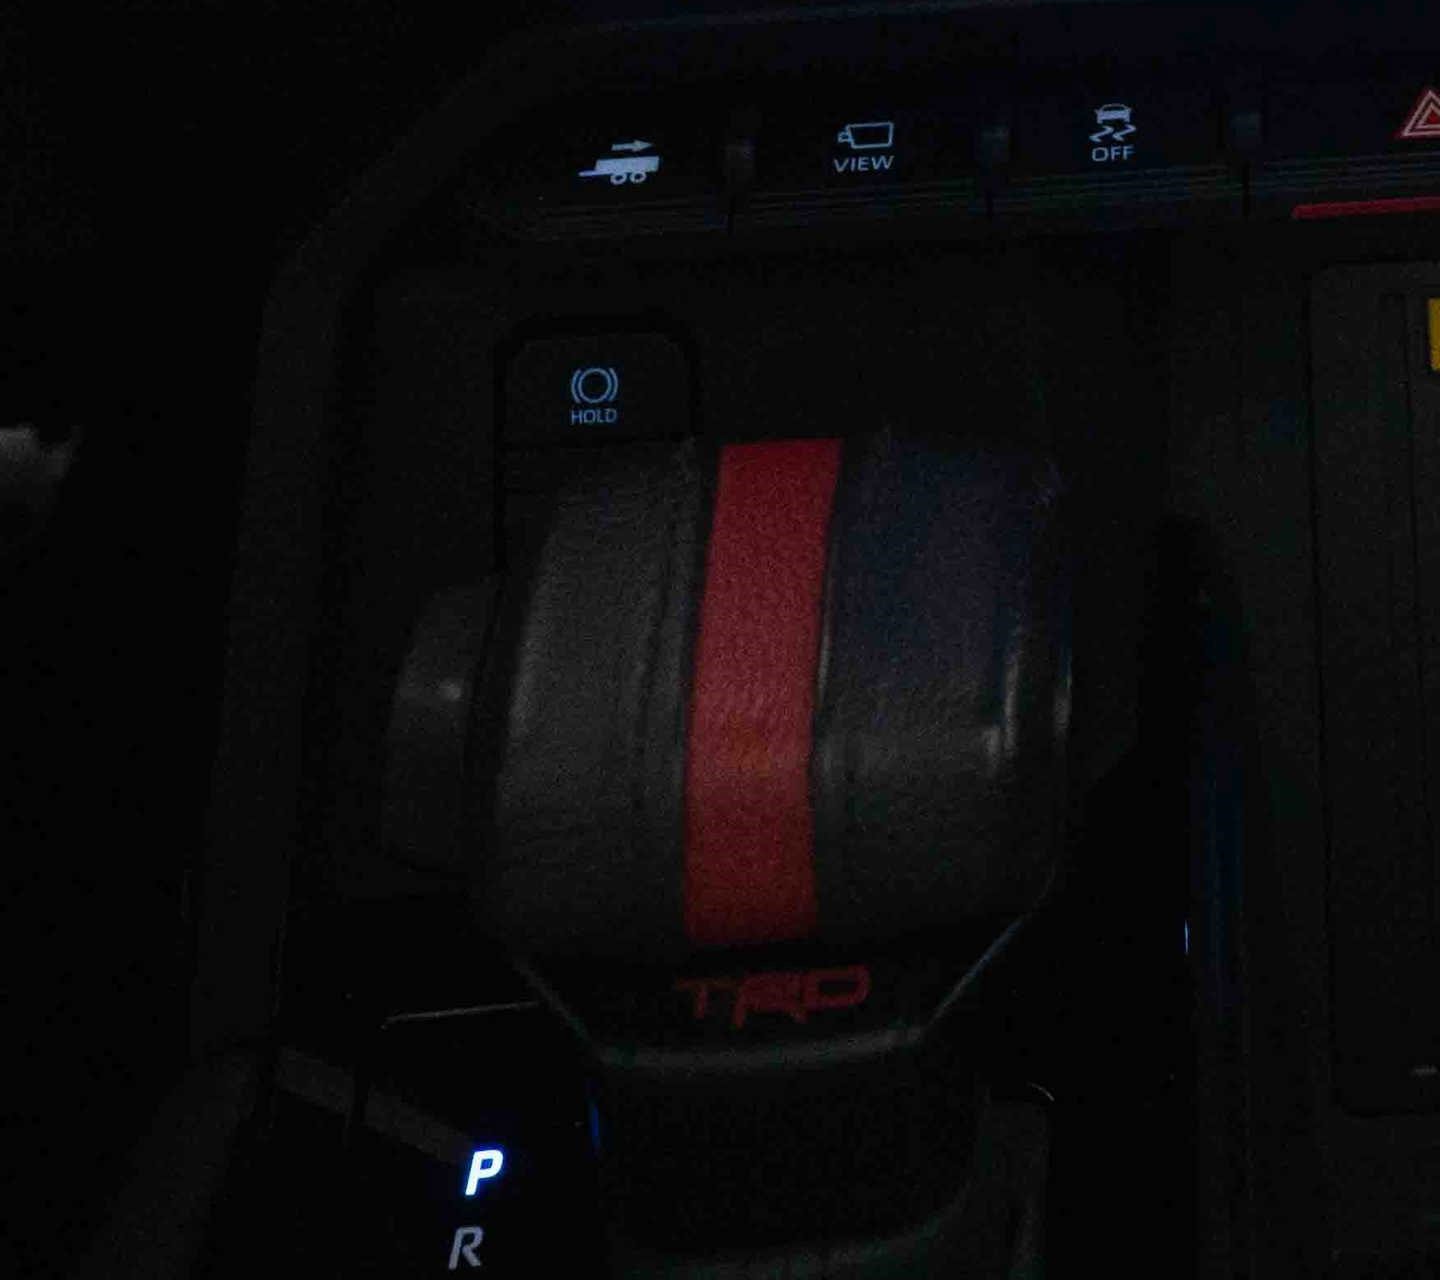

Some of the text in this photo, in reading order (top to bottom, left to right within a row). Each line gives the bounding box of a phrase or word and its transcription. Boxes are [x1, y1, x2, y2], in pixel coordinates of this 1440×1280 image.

[833, 154, 894, 173] VIEW
[1090, 144, 1136, 163] OFF
[569, 407, 618, 426] HOLD
[674, 961, 873, 1032] TRD
[465, 1148, 504, 1196] P
[447, 1224, 485, 1271] R
